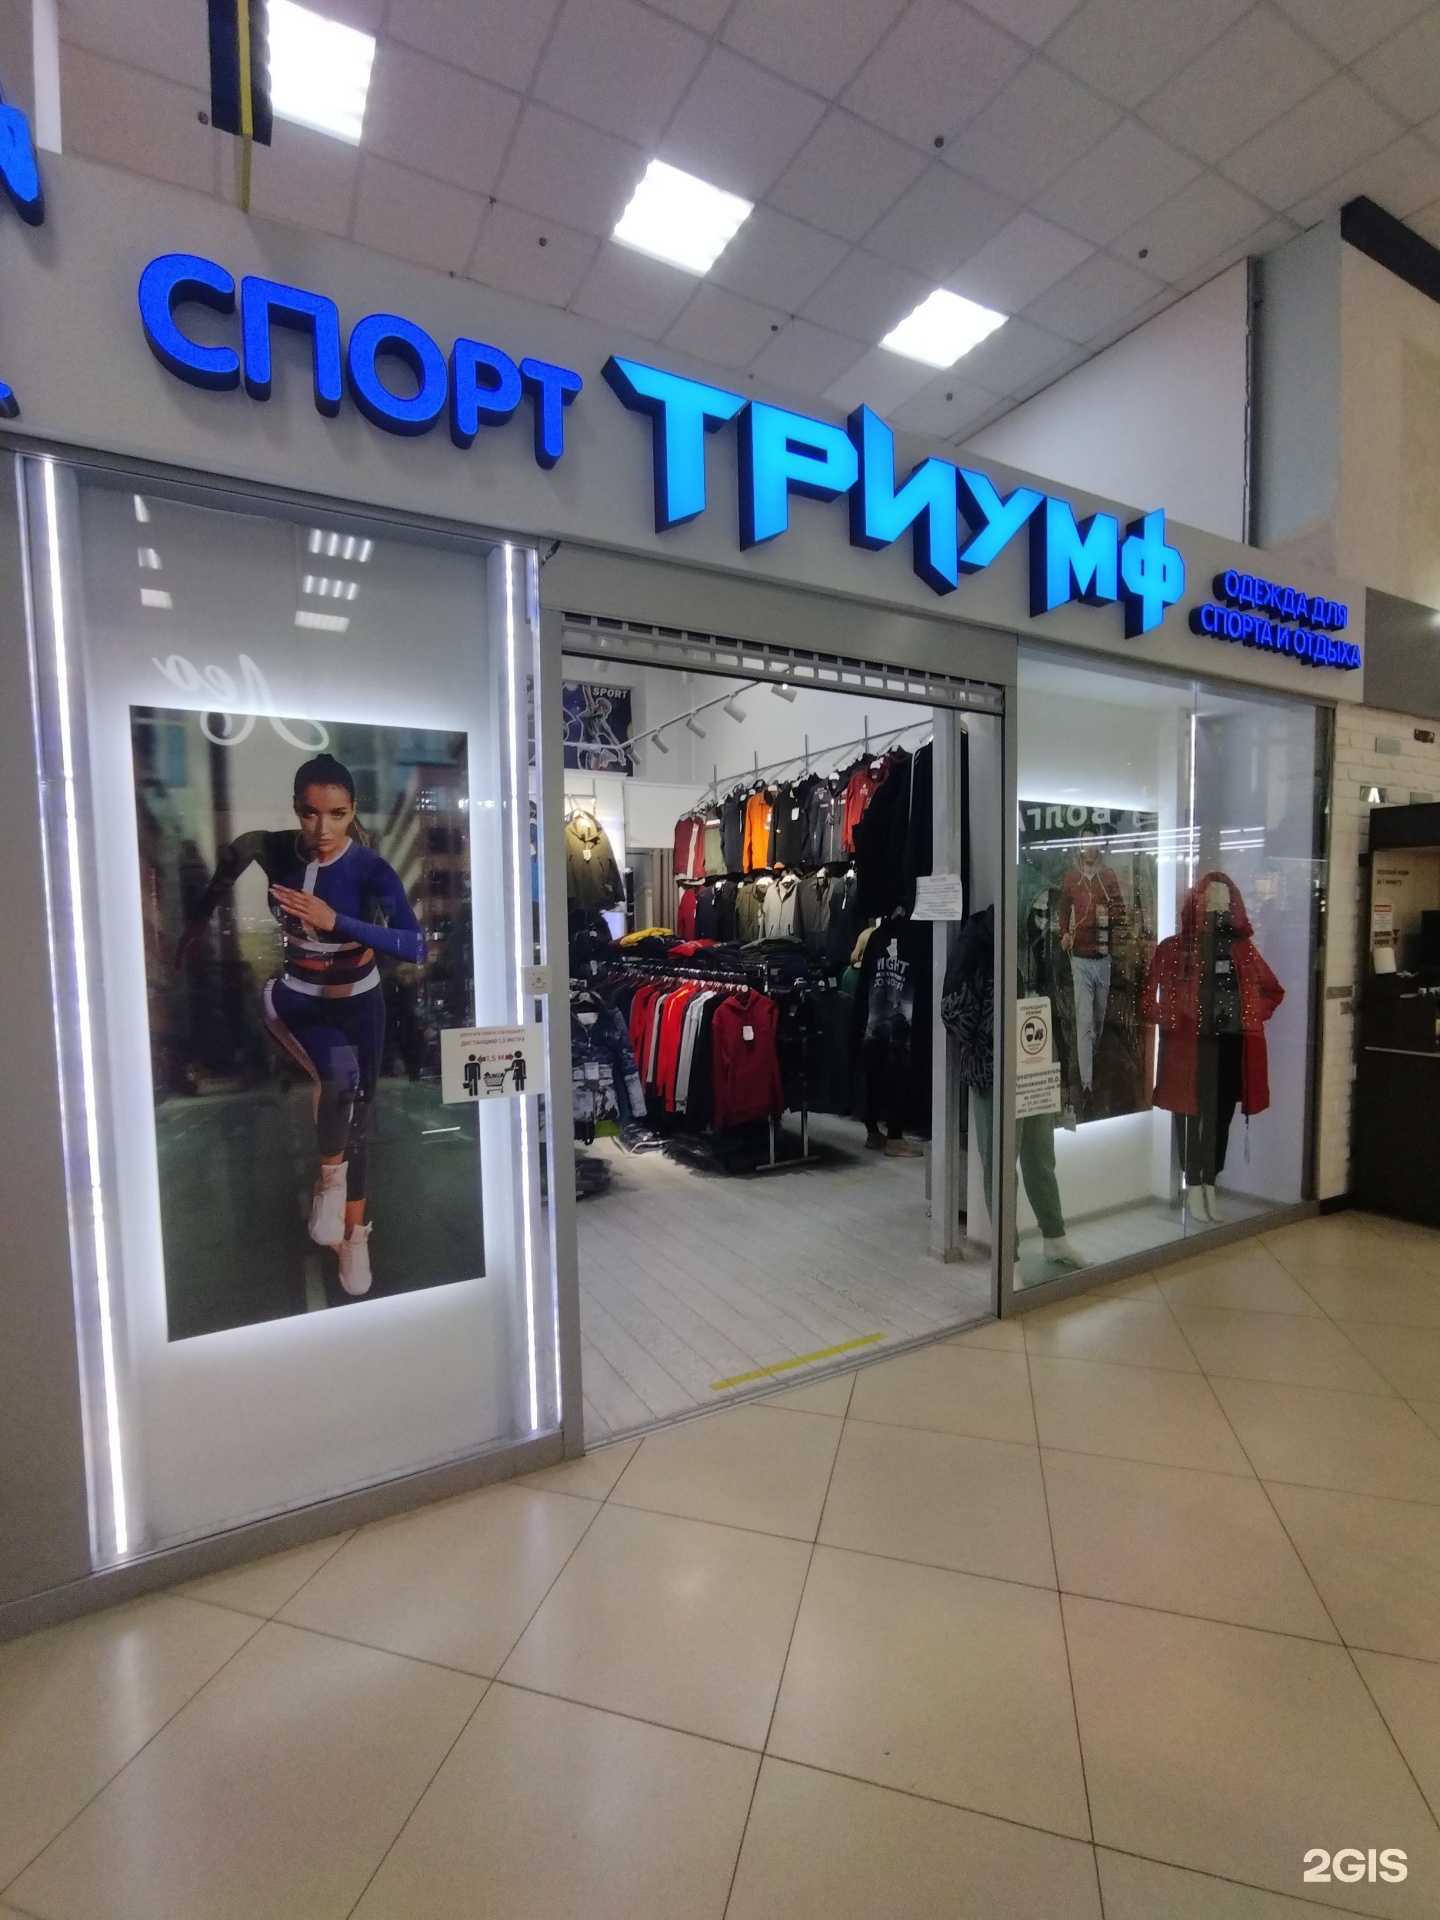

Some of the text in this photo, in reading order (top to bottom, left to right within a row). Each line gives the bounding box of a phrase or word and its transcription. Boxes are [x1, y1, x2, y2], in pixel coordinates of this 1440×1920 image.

[138, 253, 1186, 639] СПОРТ ТРИУМФ
[1214, 569, 1348, 631] ОДЕЖДА ДЛЯ
[1189, 603, 1361, 671] СПОРТА И ОТДЫХА
[592, 687, 628, 698] SPORT
